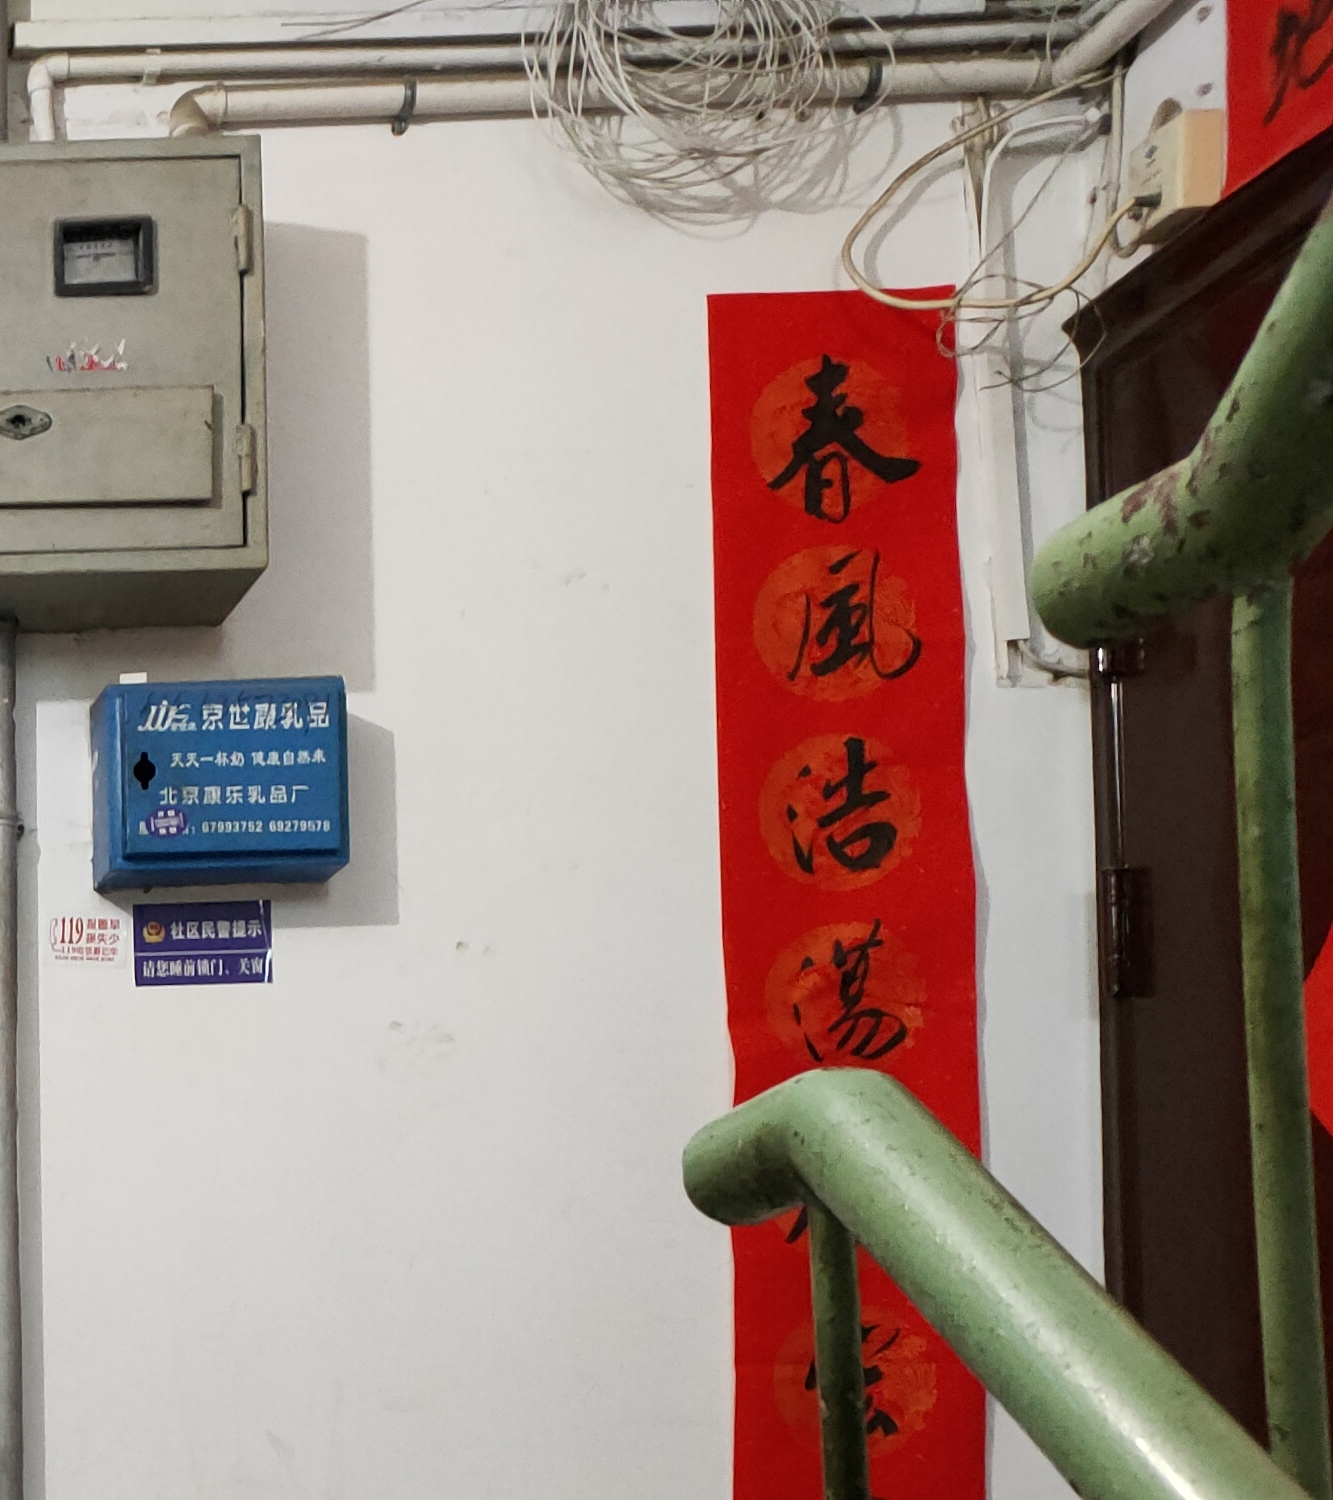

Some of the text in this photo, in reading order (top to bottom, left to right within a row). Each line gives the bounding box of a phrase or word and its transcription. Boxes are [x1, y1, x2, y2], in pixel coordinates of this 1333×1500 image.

[159, 784, 310, 806] 北京康乐乳品厂
[60, 915, 84, 945] 119
[170, 919, 263, 940] 社区民警提示
